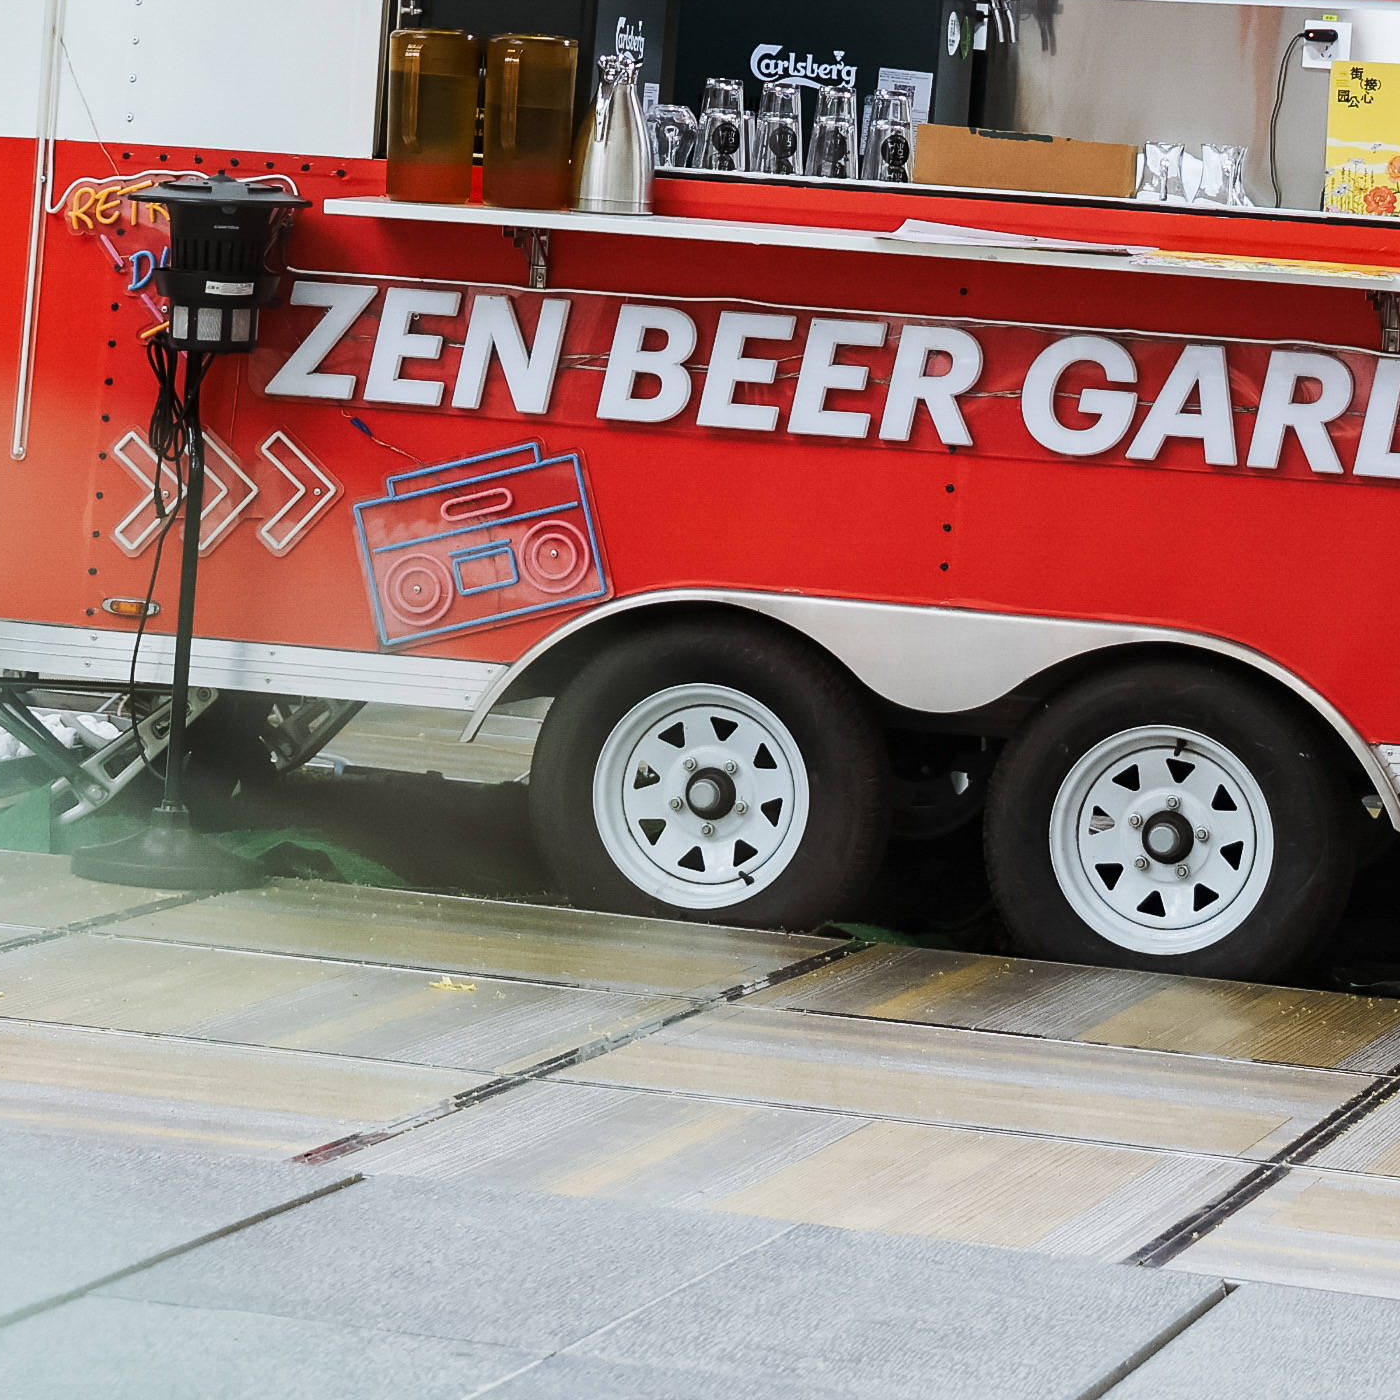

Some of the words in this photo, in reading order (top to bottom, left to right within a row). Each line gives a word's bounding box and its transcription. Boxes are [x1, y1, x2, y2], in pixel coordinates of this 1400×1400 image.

[749, 43, 858, 89] Carlsberg
[264, 280, 572, 415] ZEN
[596, 304, 984, 447] BEER
